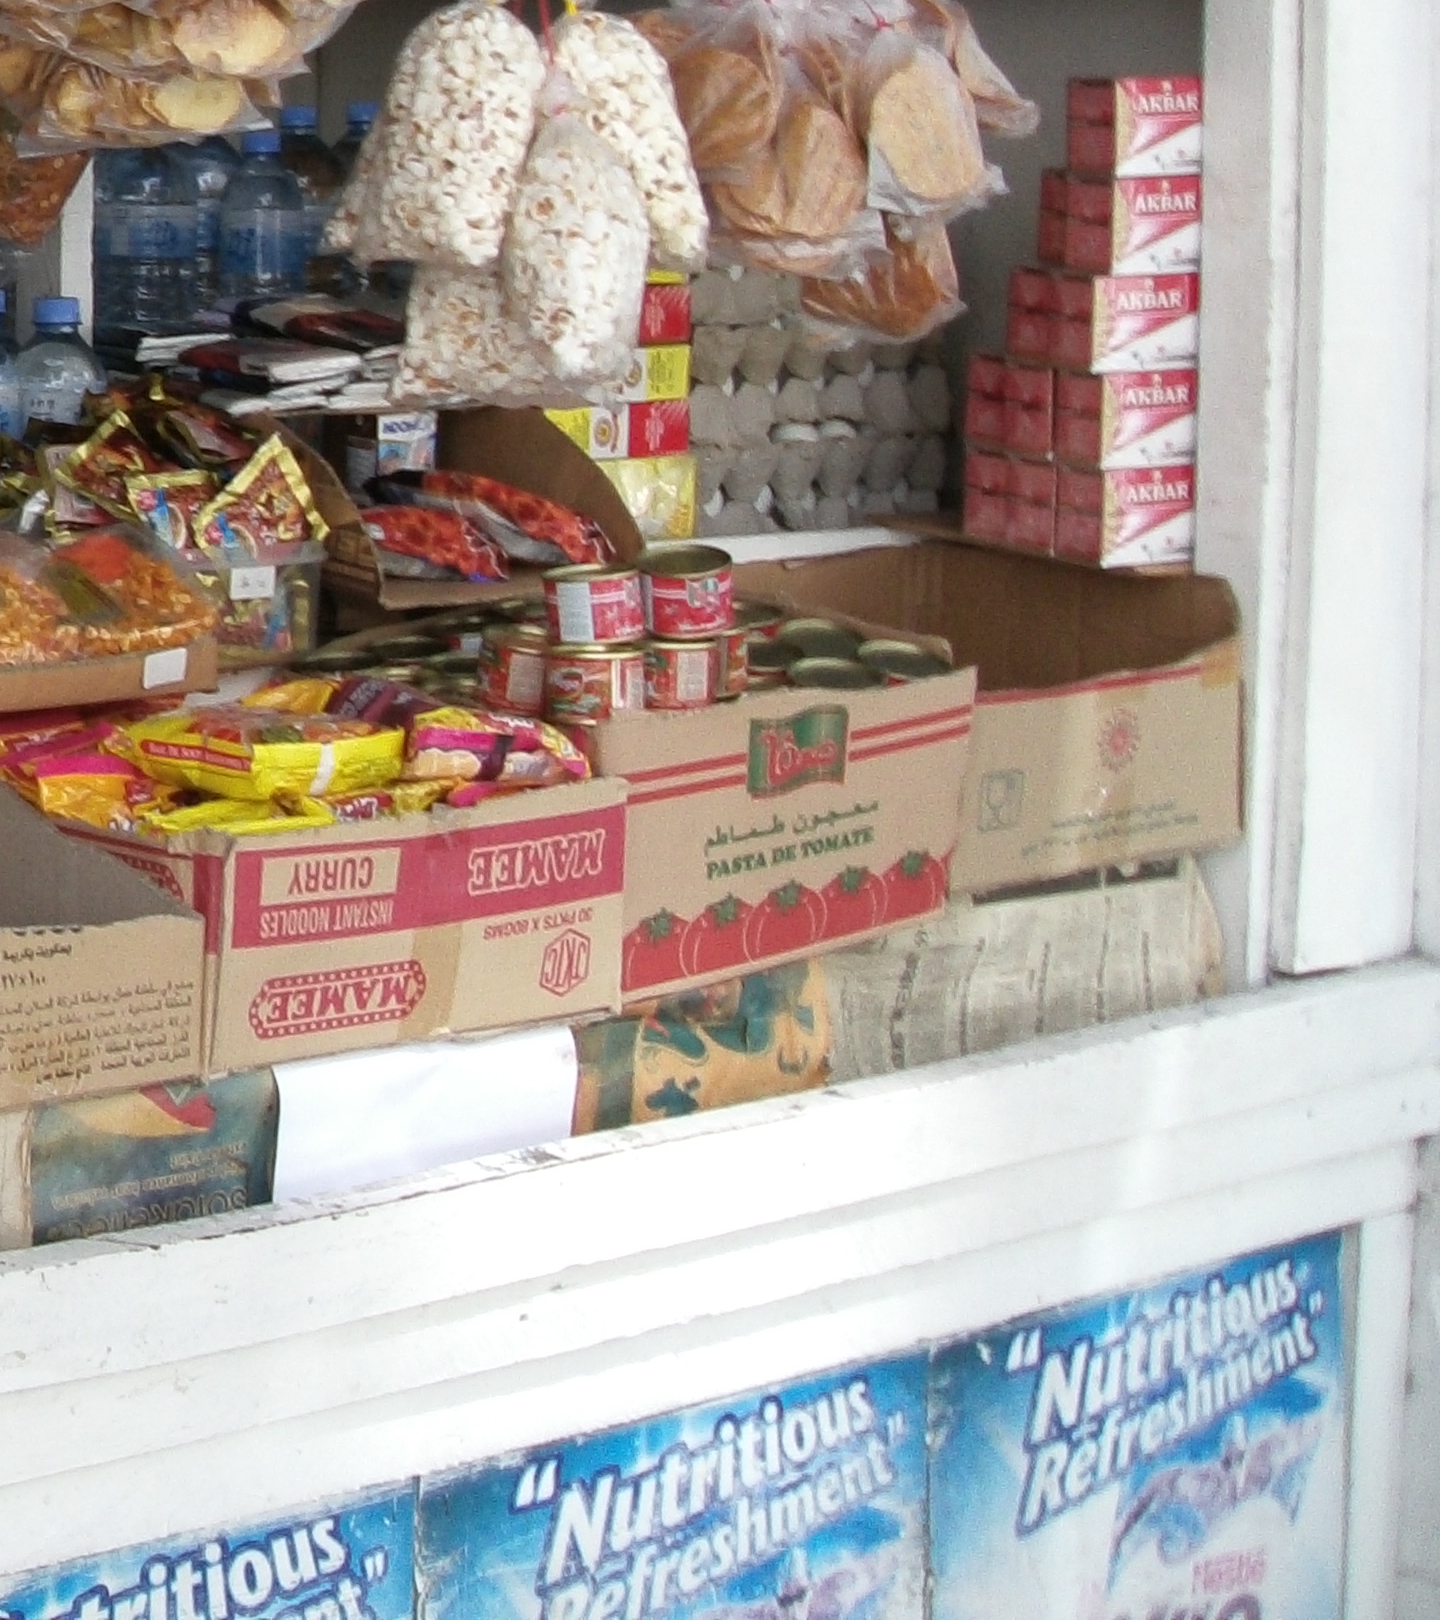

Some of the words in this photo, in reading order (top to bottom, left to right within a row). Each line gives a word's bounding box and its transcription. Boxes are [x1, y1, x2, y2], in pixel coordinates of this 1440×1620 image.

[1138, 93, 1198, 114] AKBAR
[1134, 192, 1196, 214] AKBAR
[1117, 290, 1183, 311] AKBAR
[1124, 386, 1190, 406] AKBAR
[1126, 484, 1189, 504] AKBAR
[468, 829, 606, 896] MAMEE
[706, 854, 767, 880] PASTA
[771, 846, 796, 866] DE
[800, 826, 875, 859] TOMATE
[288, 856, 375, 896] CURRY
[260, 906, 331, 939] NOODLES
[332, 899, 395, 933] INSTANT
[530, 917, 541, 933] X
[541, 910, 575, 929] PKTS
[577, 907, 593, 924] 30
[266, 976, 411, 1024] MAMEE
